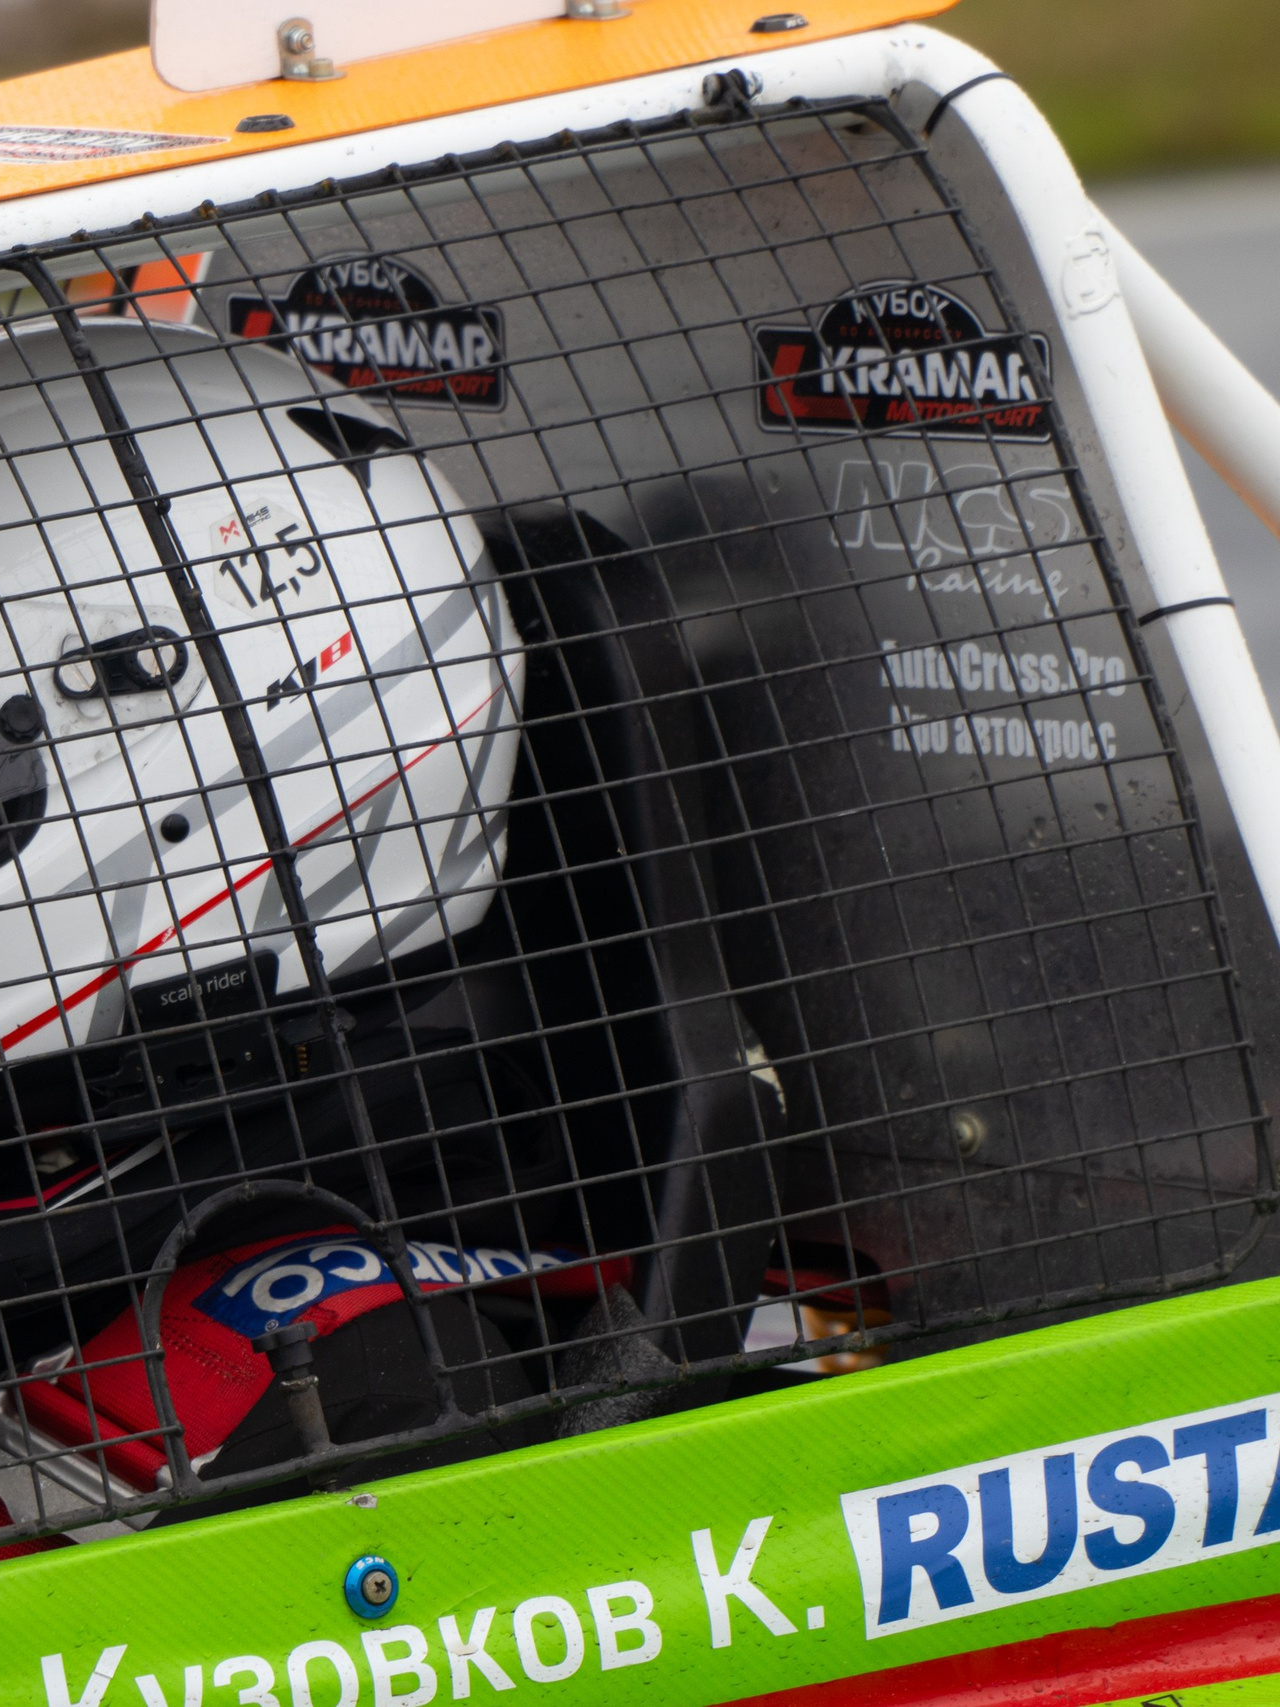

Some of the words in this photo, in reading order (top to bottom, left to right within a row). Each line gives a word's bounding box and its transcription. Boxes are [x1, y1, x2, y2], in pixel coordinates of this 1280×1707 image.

[851, 289, 951, 323] КУБОК
[286, 312, 496, 370] KRAMAR
[885, 400, 1043, 428] MOTORSPORT
[206, 968, 248, 994] rider
[877, 1408, 1280, 1626] RUST
